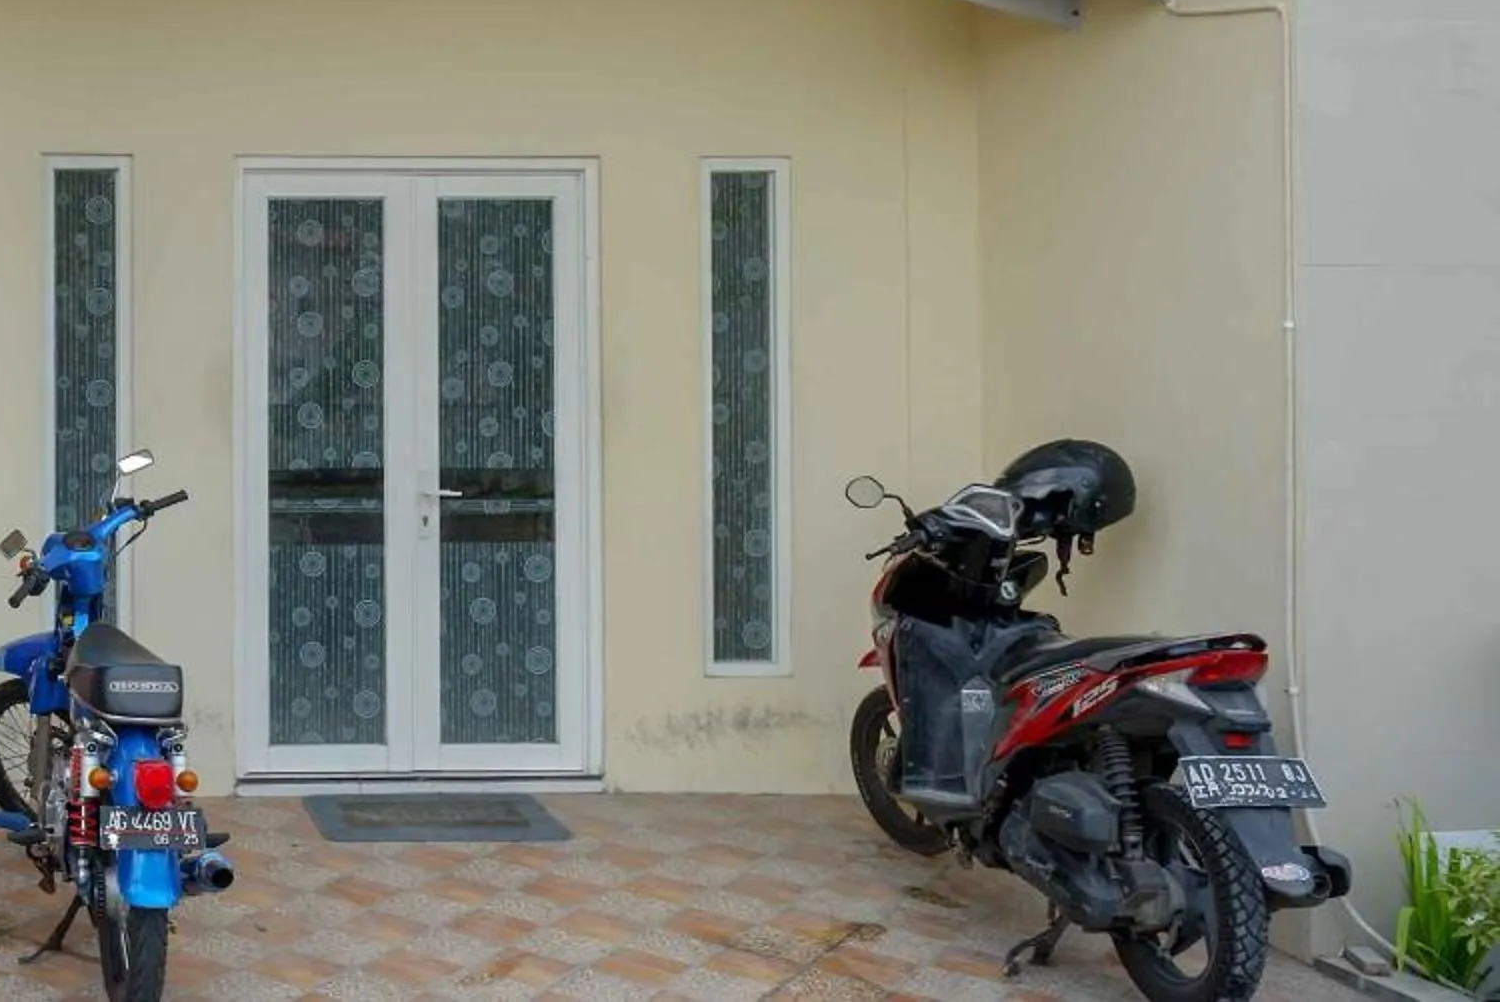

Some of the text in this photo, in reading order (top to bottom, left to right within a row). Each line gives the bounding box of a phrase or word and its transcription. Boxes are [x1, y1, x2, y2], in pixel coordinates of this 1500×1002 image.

[1188, 763, 1215, 784] AD
[1219, 763, 1267, 783] 2511
[131, 811, 173, 831] 4469
